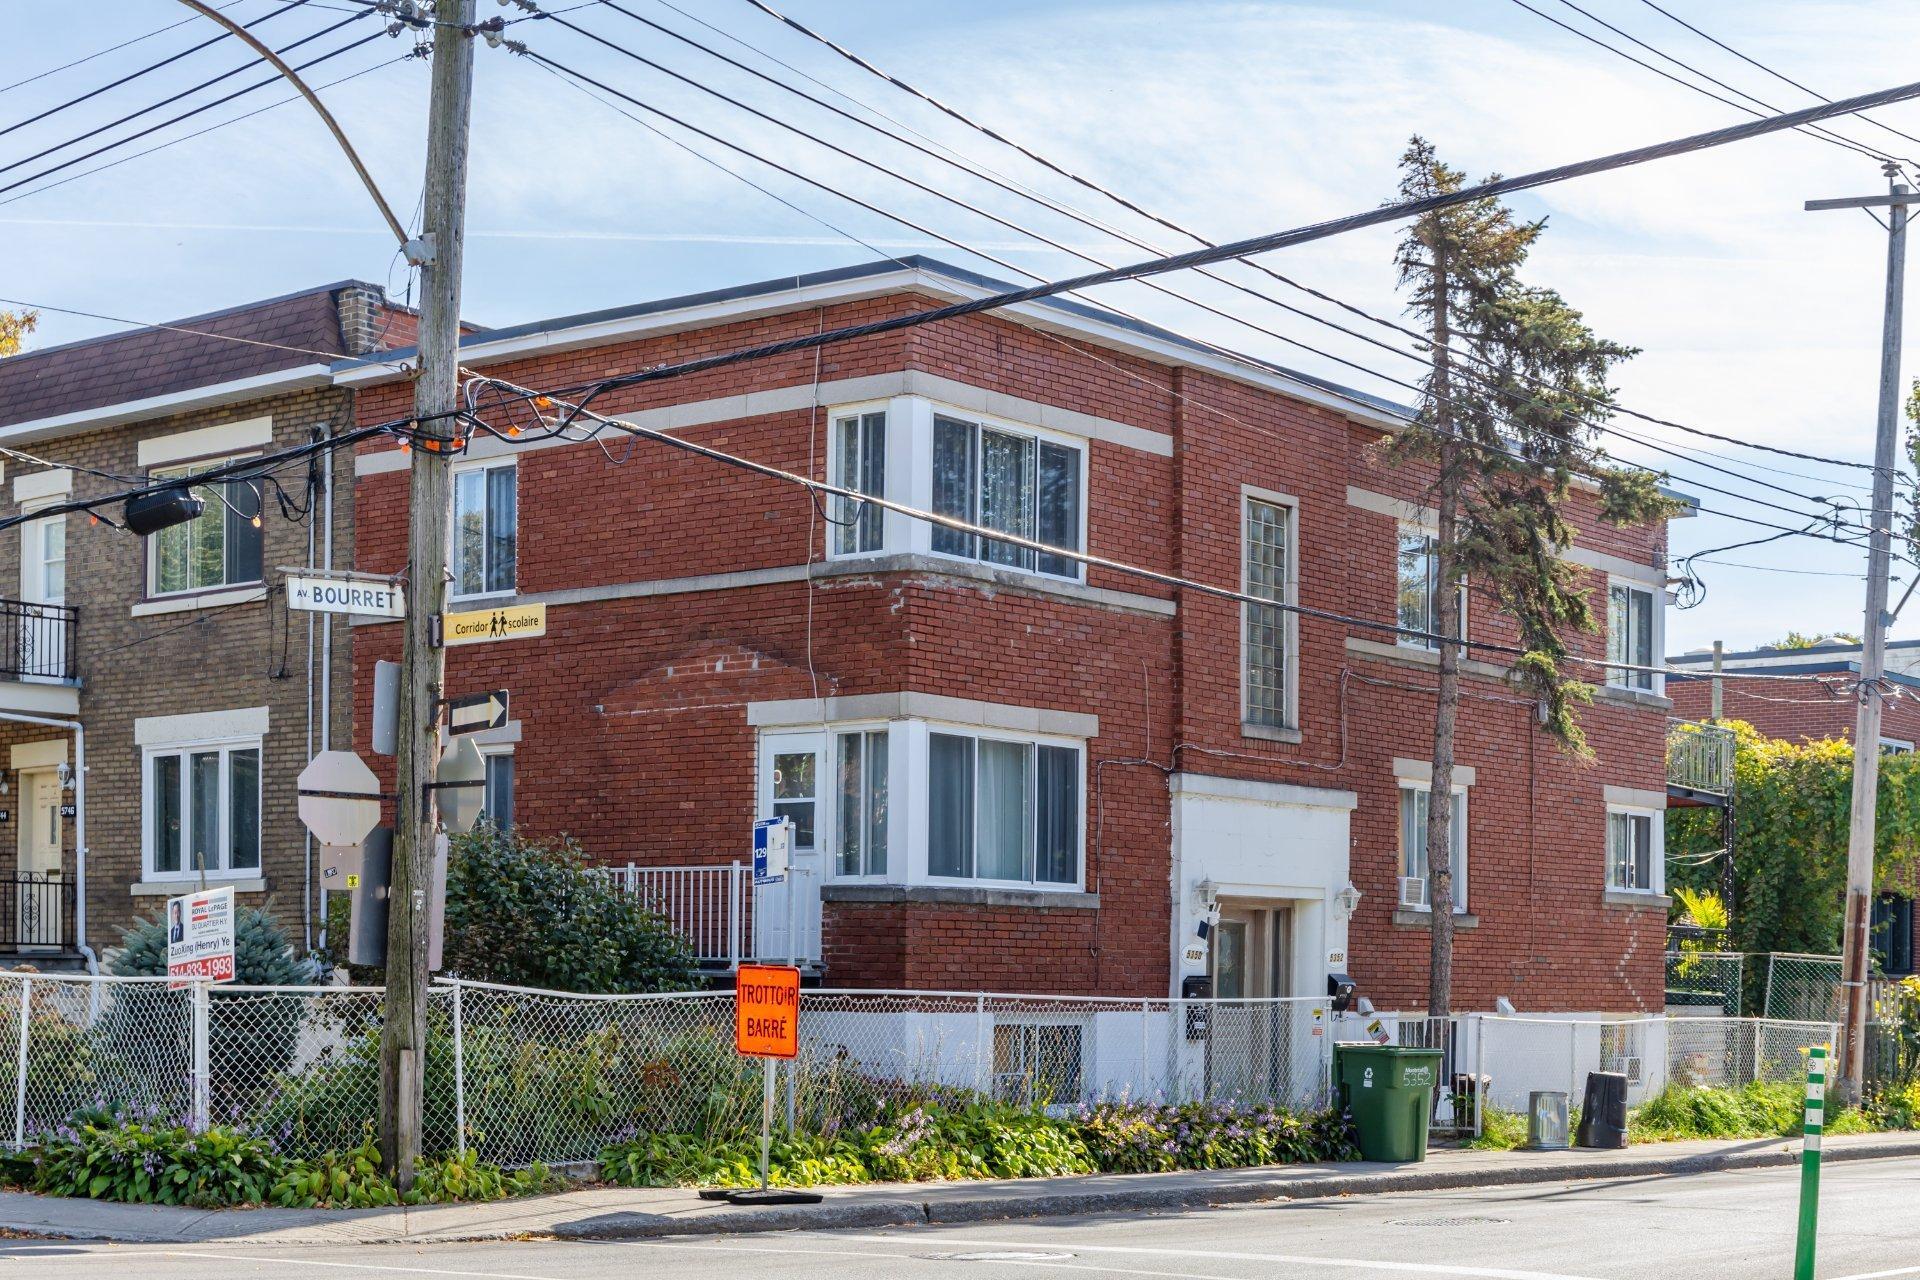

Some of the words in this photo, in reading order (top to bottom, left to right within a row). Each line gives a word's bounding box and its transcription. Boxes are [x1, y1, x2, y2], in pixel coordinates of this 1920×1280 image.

[297, 589, 310, 598] AV.
[313, 586, 396, 609] BOURRET
[455, 622, 489, 635] Corridor
[508, 616, 539, 629] scolaire
[61, 806, 75, 815] 5746
[755, 847, 767, 859] 129
[192, 906, 207, 915] ROYAL
[195, 938, 220, 952] (Henry)
[222, 936, 230, 946] Ye
[1329, 953, 1344, 962] 5352
[170, 957, 232, 977] 514-833-1993
[1403, 1072, 1431, 1087] 5352
